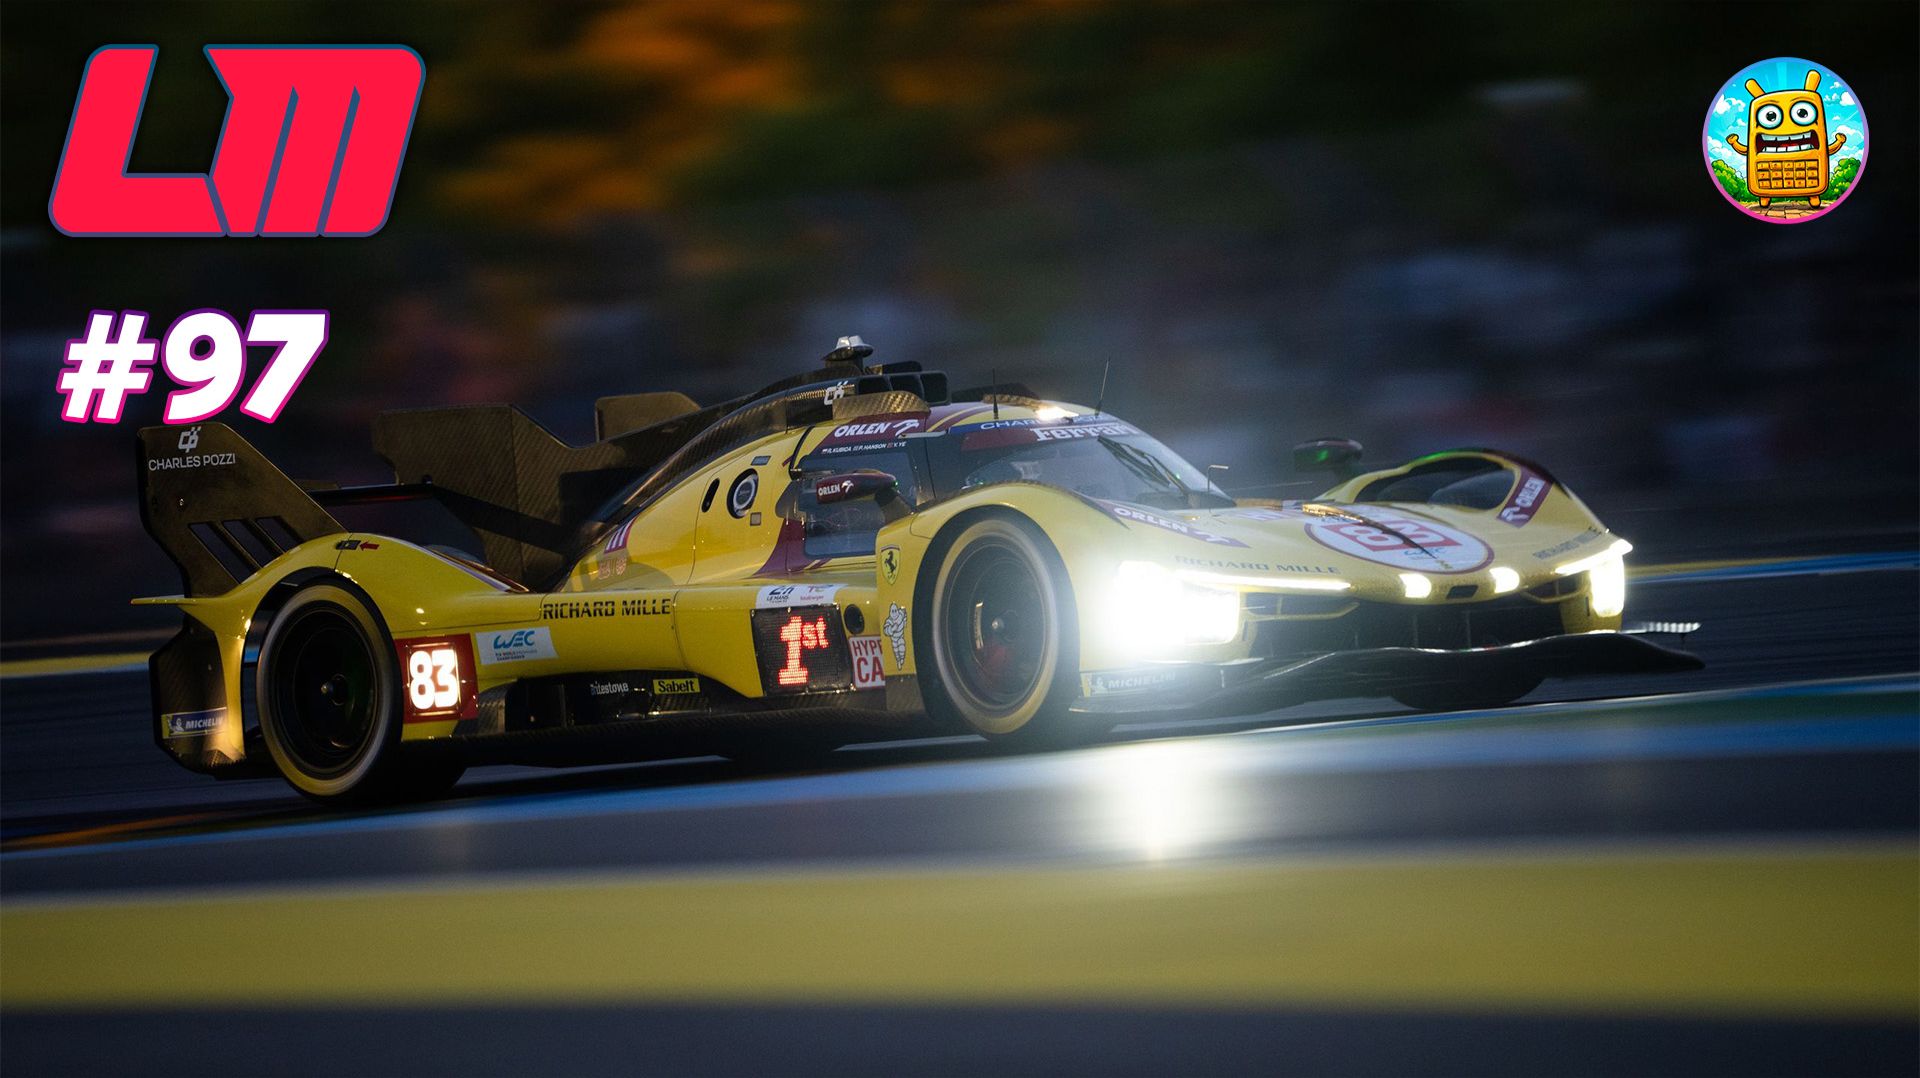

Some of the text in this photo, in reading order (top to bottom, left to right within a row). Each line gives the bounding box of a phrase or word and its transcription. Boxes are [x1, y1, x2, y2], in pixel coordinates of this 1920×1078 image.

[834, 422, 892, 438] ORLEN
[1030, 422, 1139, 442] Ferrari
[148, 453, 236, 471] CHARLES POZZI
[818, 484, 840, 497] ORLEN
[1114, 506, 1189, 534] ORLEN
[1175, 555, 1341, 575] RICHARD MILLE
[543, 599, 671, 620] RICHARD MILLE
[493, 630, 535, 649] WEC
[778, 616, 829, 685] 1st
[409, 648, 458, 710] 83
[658, 679, 695, 693] Sabelt
[1108, 671, 1176, 689] MICHELIN
